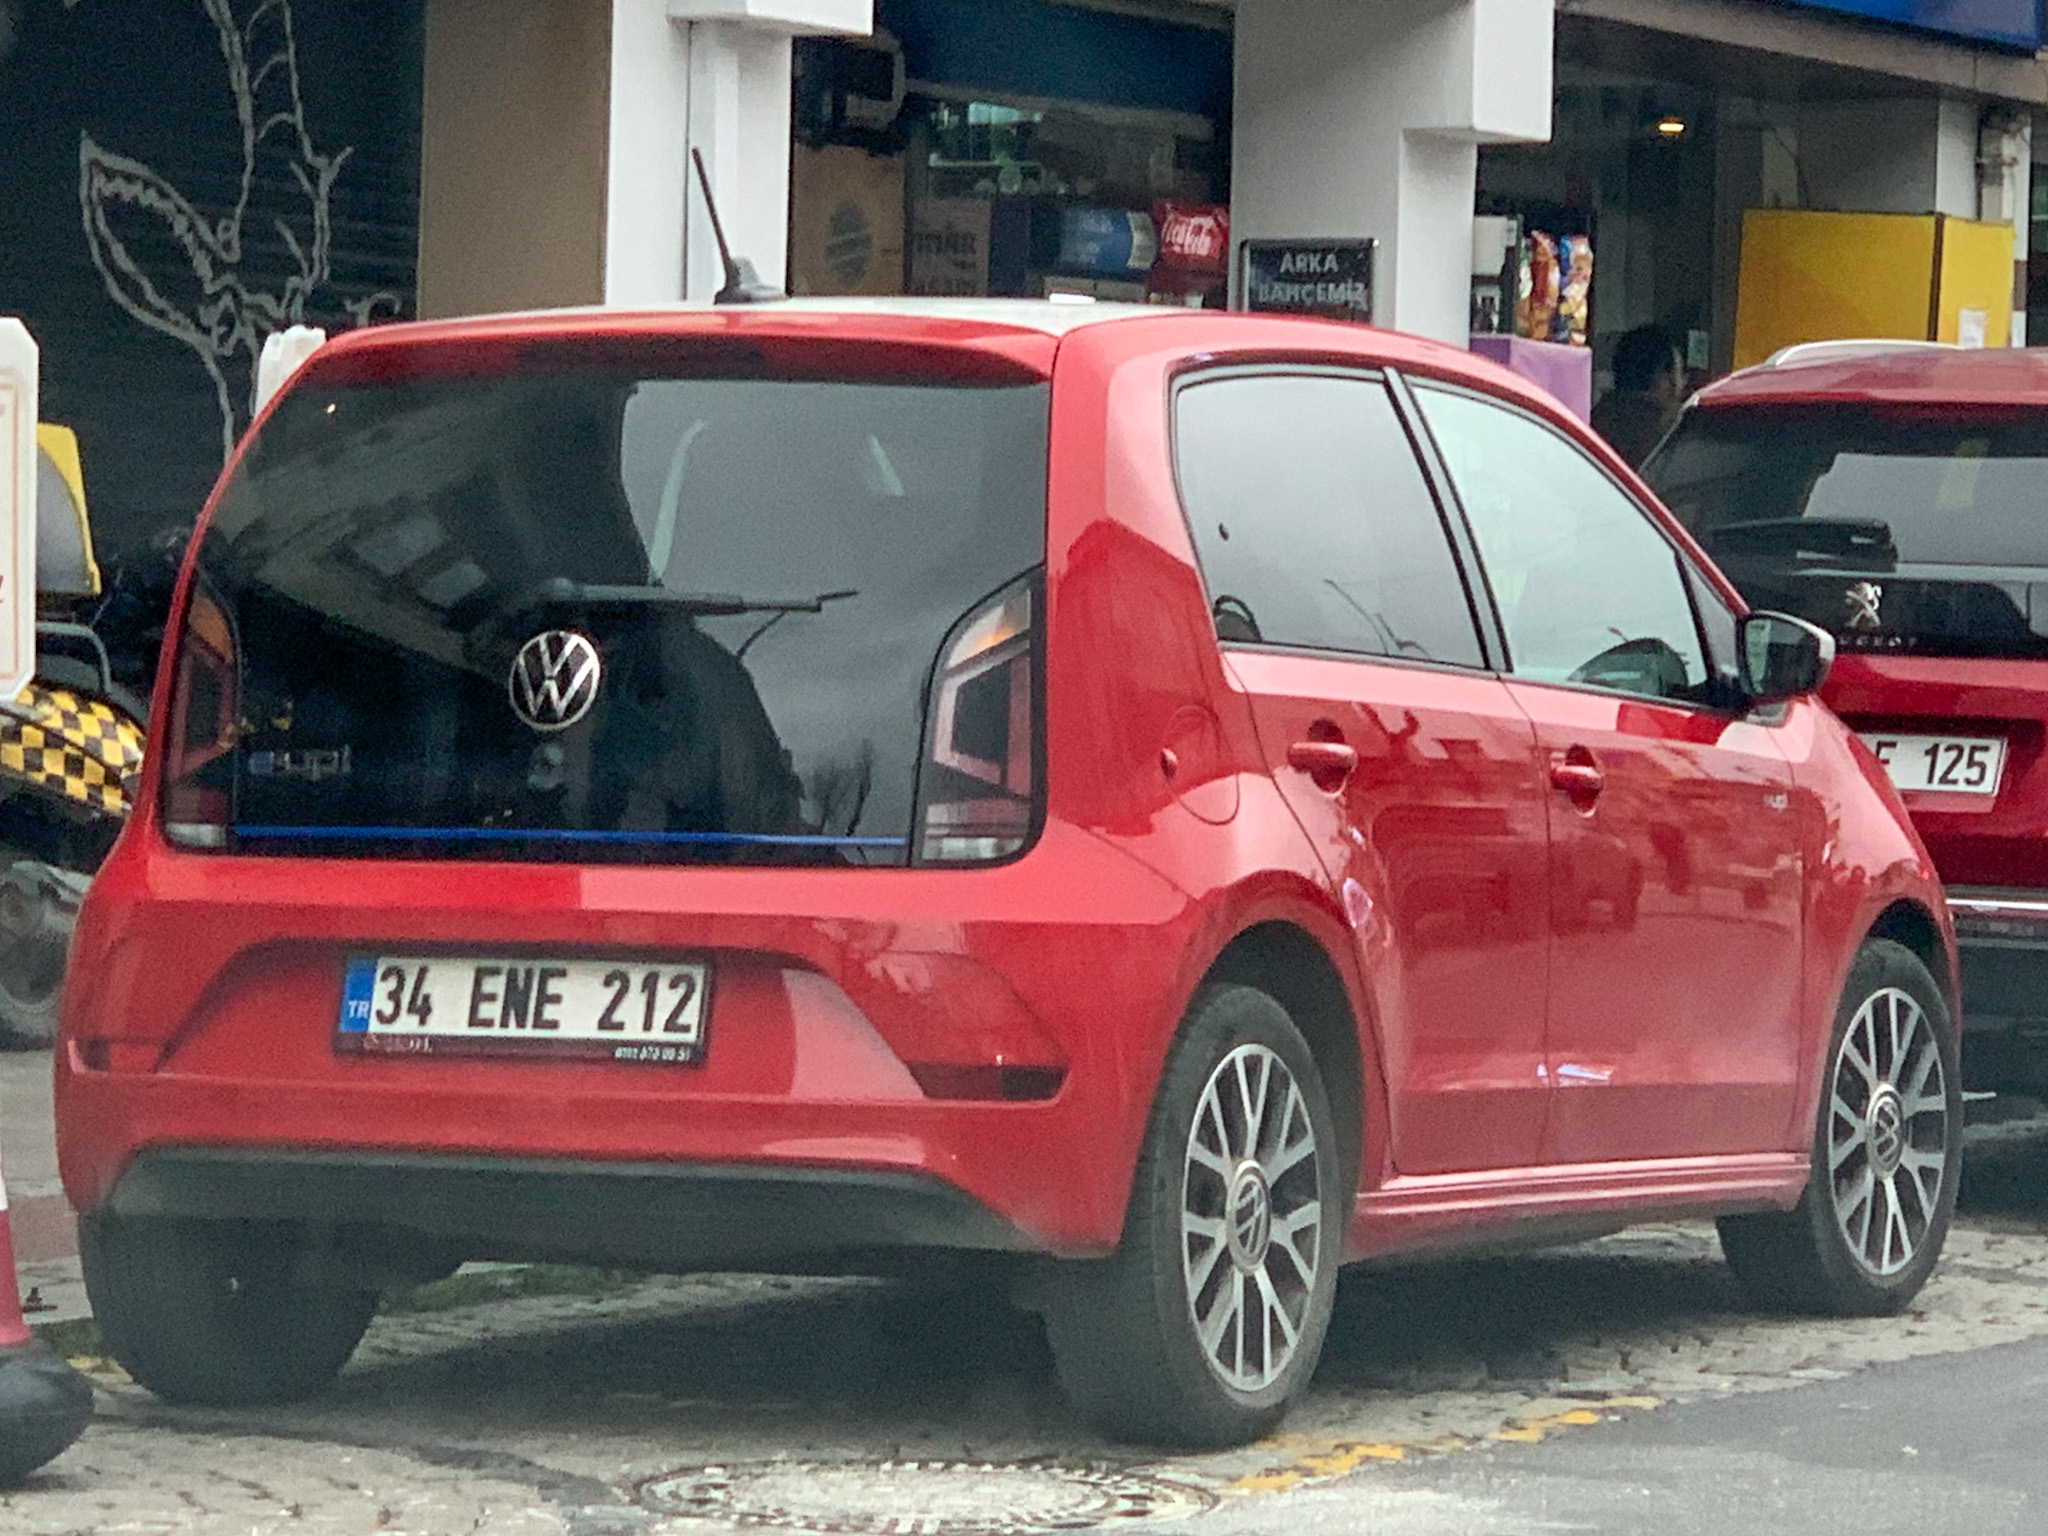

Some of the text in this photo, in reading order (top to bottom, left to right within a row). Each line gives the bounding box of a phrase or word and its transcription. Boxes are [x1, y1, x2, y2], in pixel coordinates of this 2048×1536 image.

[1279, 252, 1340, 273] ARKA
[512, 631, 598, 726] VW
[1924, 742, 1991, 787] 125
[348, 1000, 371, 1019] TR
[375, 965, 697, 1034] 34 ENE 212
